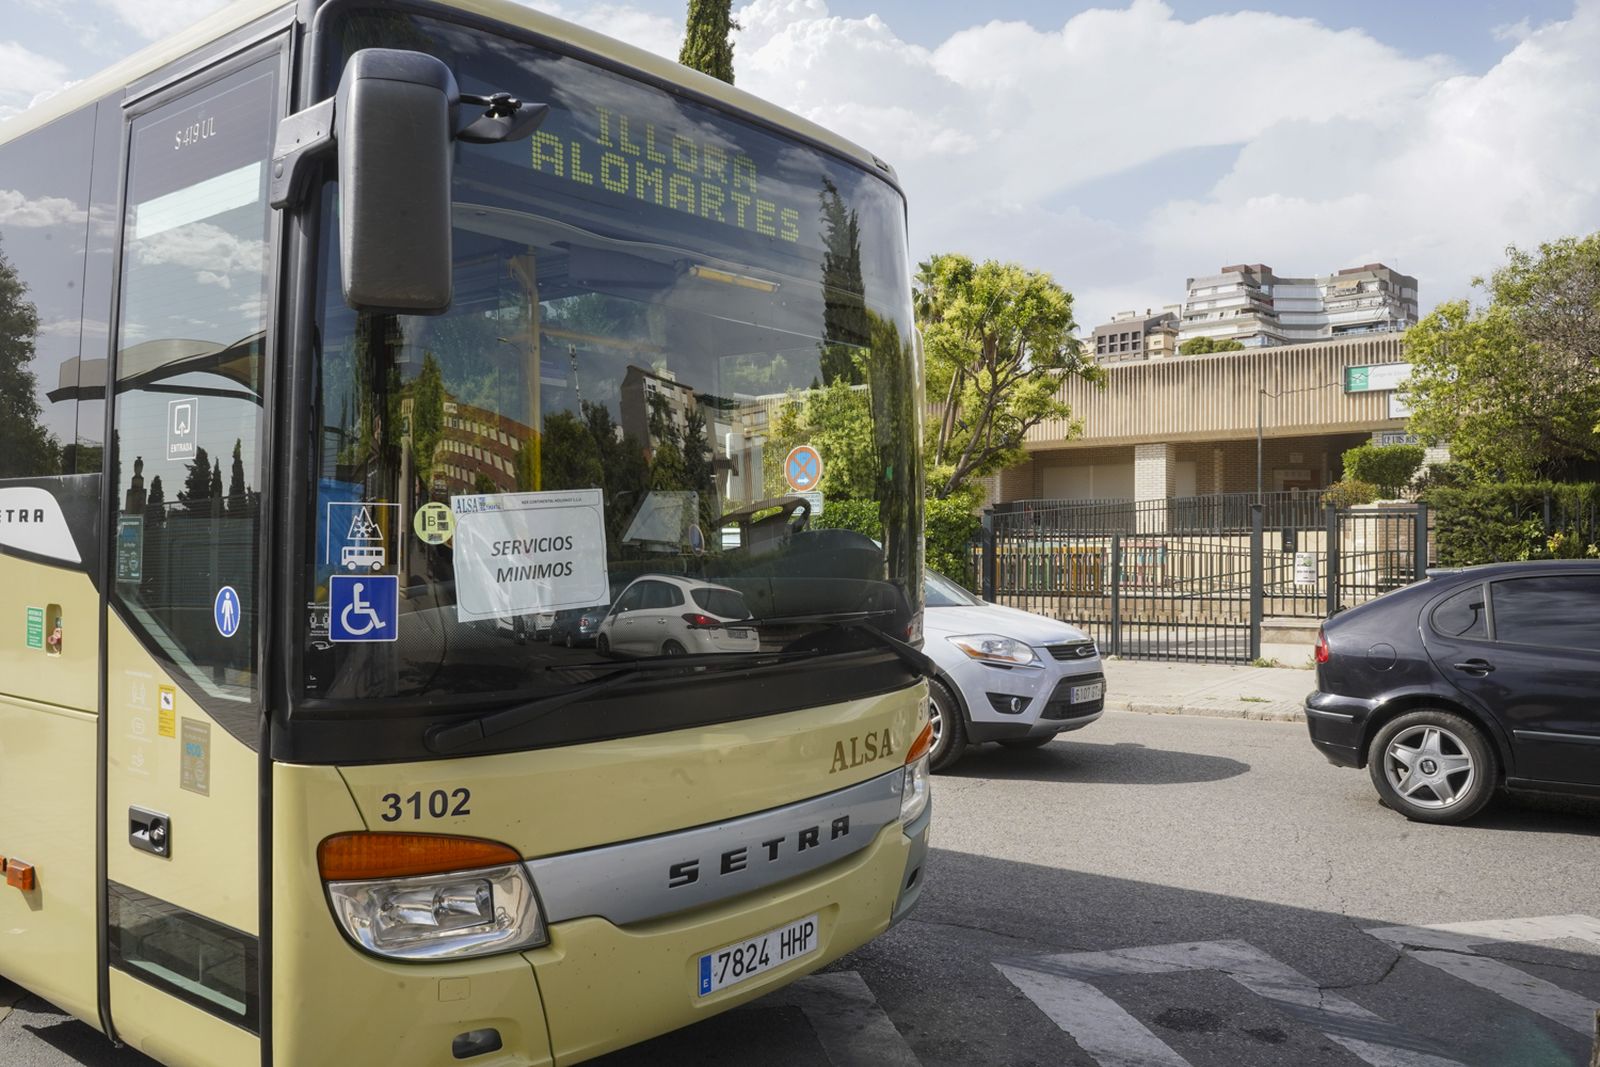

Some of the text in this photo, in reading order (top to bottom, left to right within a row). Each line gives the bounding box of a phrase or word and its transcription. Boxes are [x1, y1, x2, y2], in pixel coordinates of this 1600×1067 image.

[174, 117, 217, 150] S 419 UL
[596, 105, 758, 193] ILLORA
[531, 130, 800, 243] ALOMARTES
[0, 508, 44, 523] TRA
[427, 516, 436, 527] B
[455, 497, 479, 514] ALSA
[491, 535, 573, 557] SERVICIOS
[496, 561, 573, 584] MINIMOS
[829, 728, 894, 774] ALSA
[381, 787, 472, 823] 3102
[668, 814, 851, 889] SETRA
[718, 921, 814, 984] 7824 HHP
[703, 978, 709, 988] E
